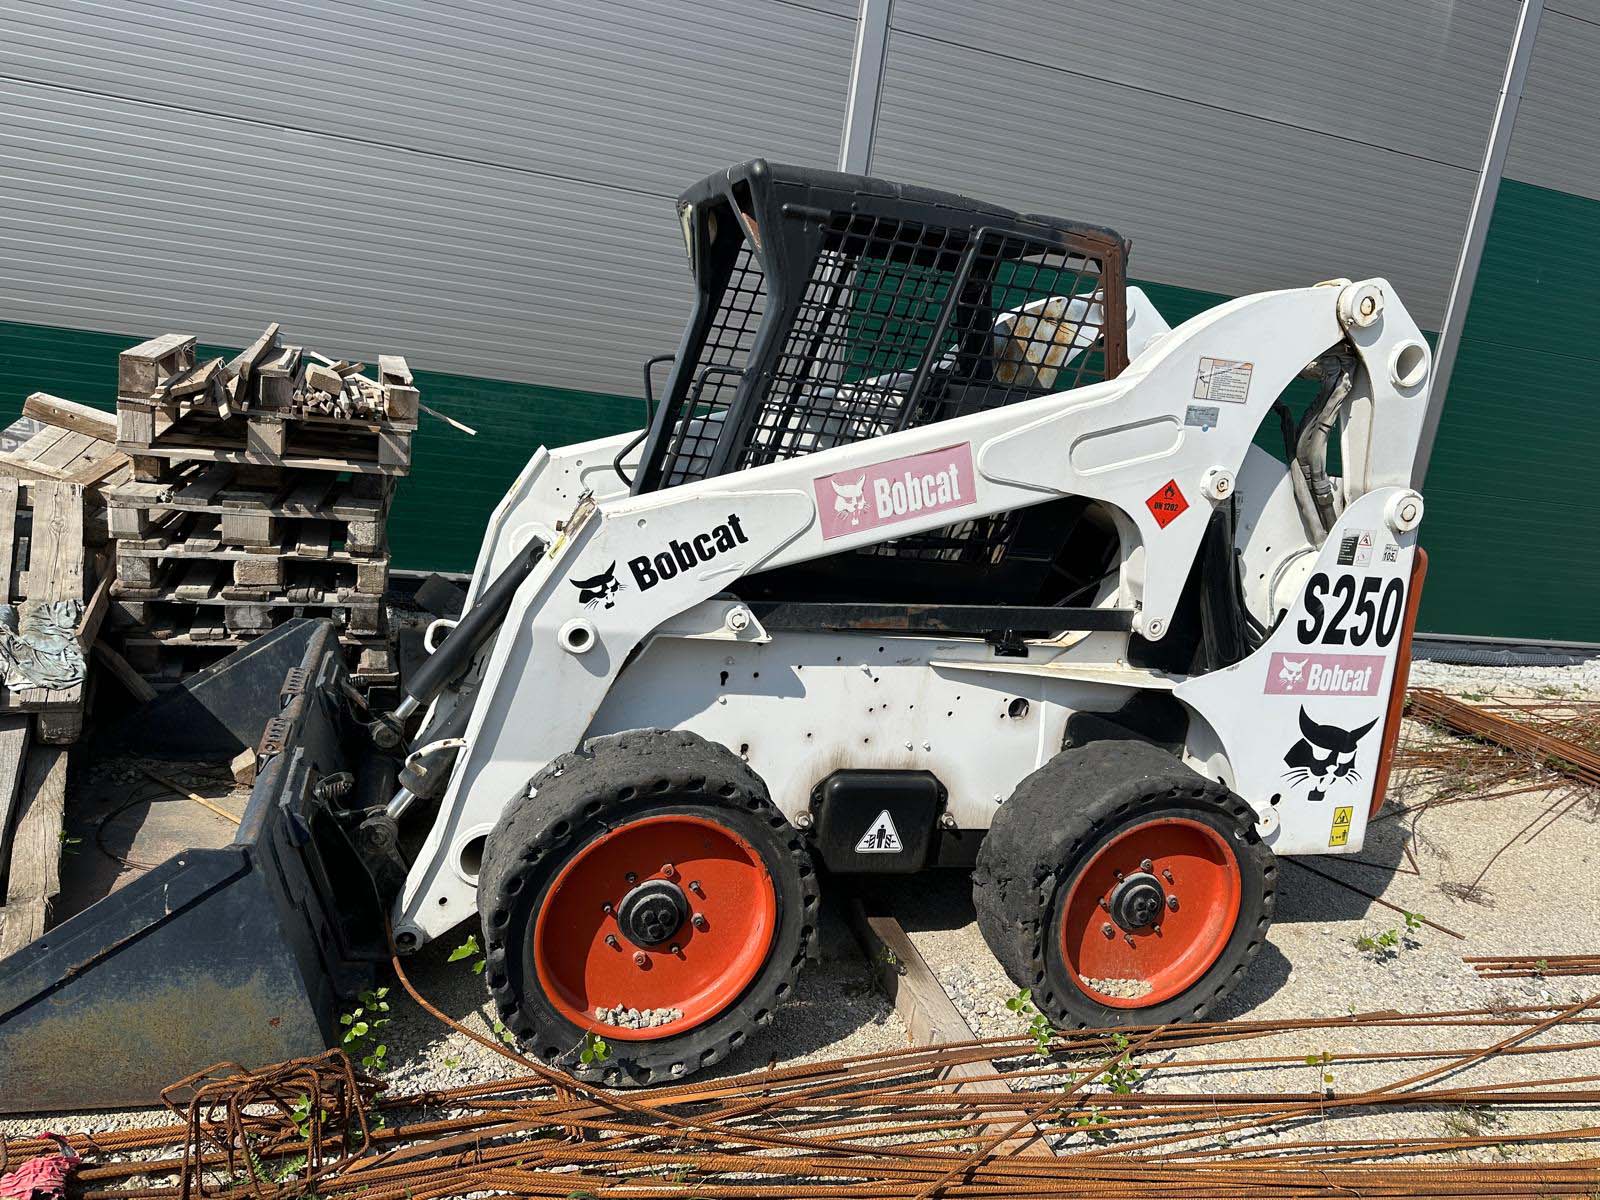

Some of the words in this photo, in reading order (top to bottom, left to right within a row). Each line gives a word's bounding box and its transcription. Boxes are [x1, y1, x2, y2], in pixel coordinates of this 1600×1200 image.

[873, 463, 961, 518] Bobcat
[1164, 502, 1179, 512] 1202
[628, 513, 749, 592] Bobcat
[1297, 572, 1404, 648] S250
[1306, 663, 1372, 692] Bobcat
